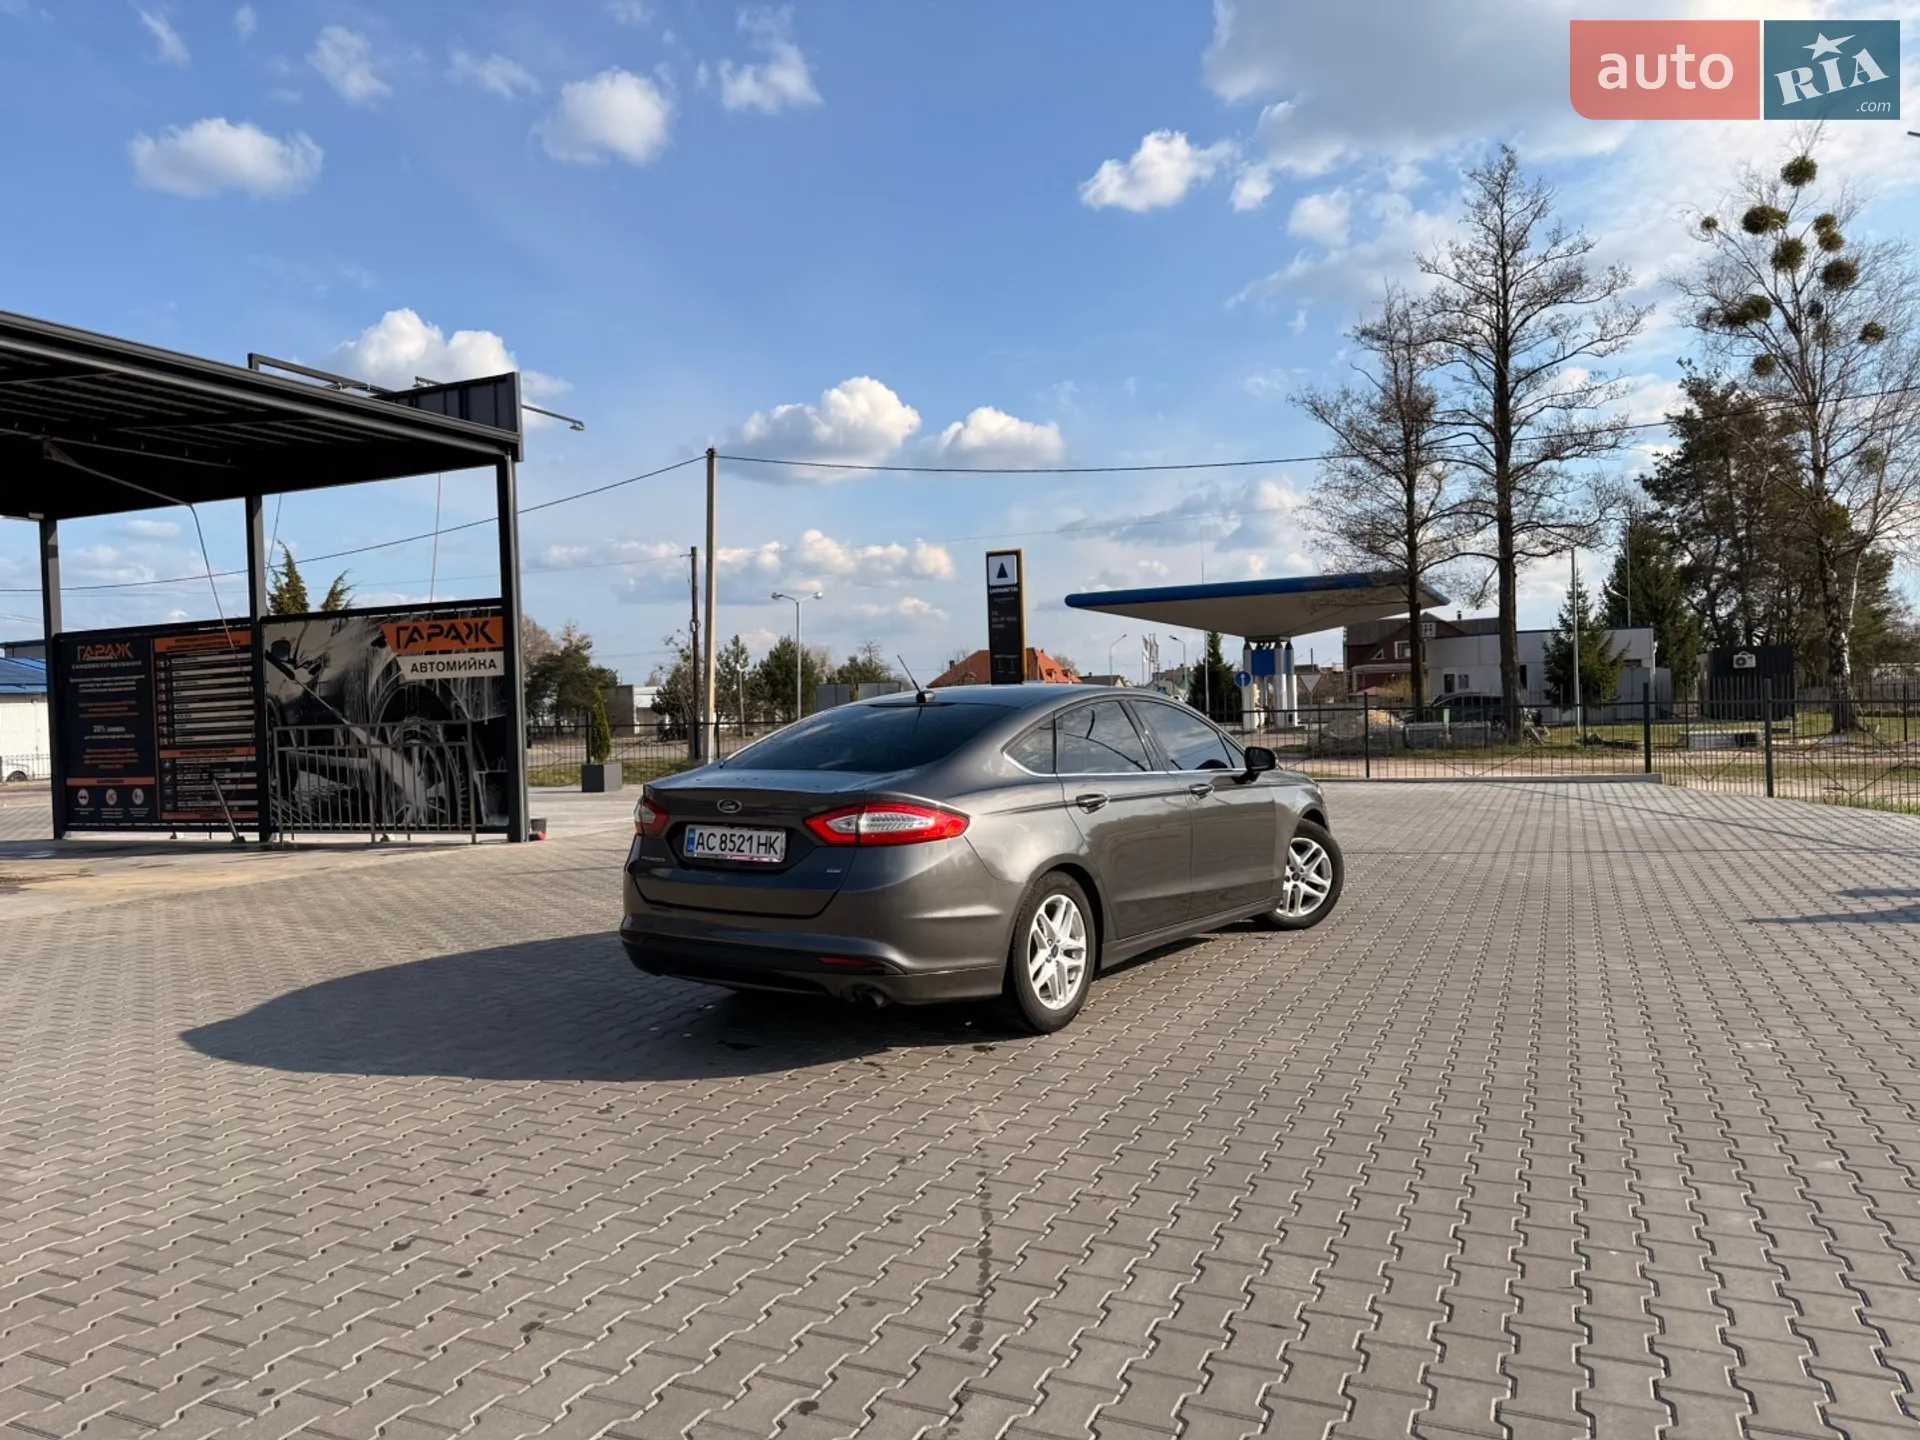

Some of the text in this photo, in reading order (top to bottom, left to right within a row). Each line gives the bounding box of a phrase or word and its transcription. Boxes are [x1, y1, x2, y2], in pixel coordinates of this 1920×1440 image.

[395, 621, 496, 649] ГАРАЖ
[76, 642, 134, 661] ГАРАЖ
[410, 657, 498, 674] АВТОМИЙКА
[695, 832, 780, 856] AC 8521 HK
